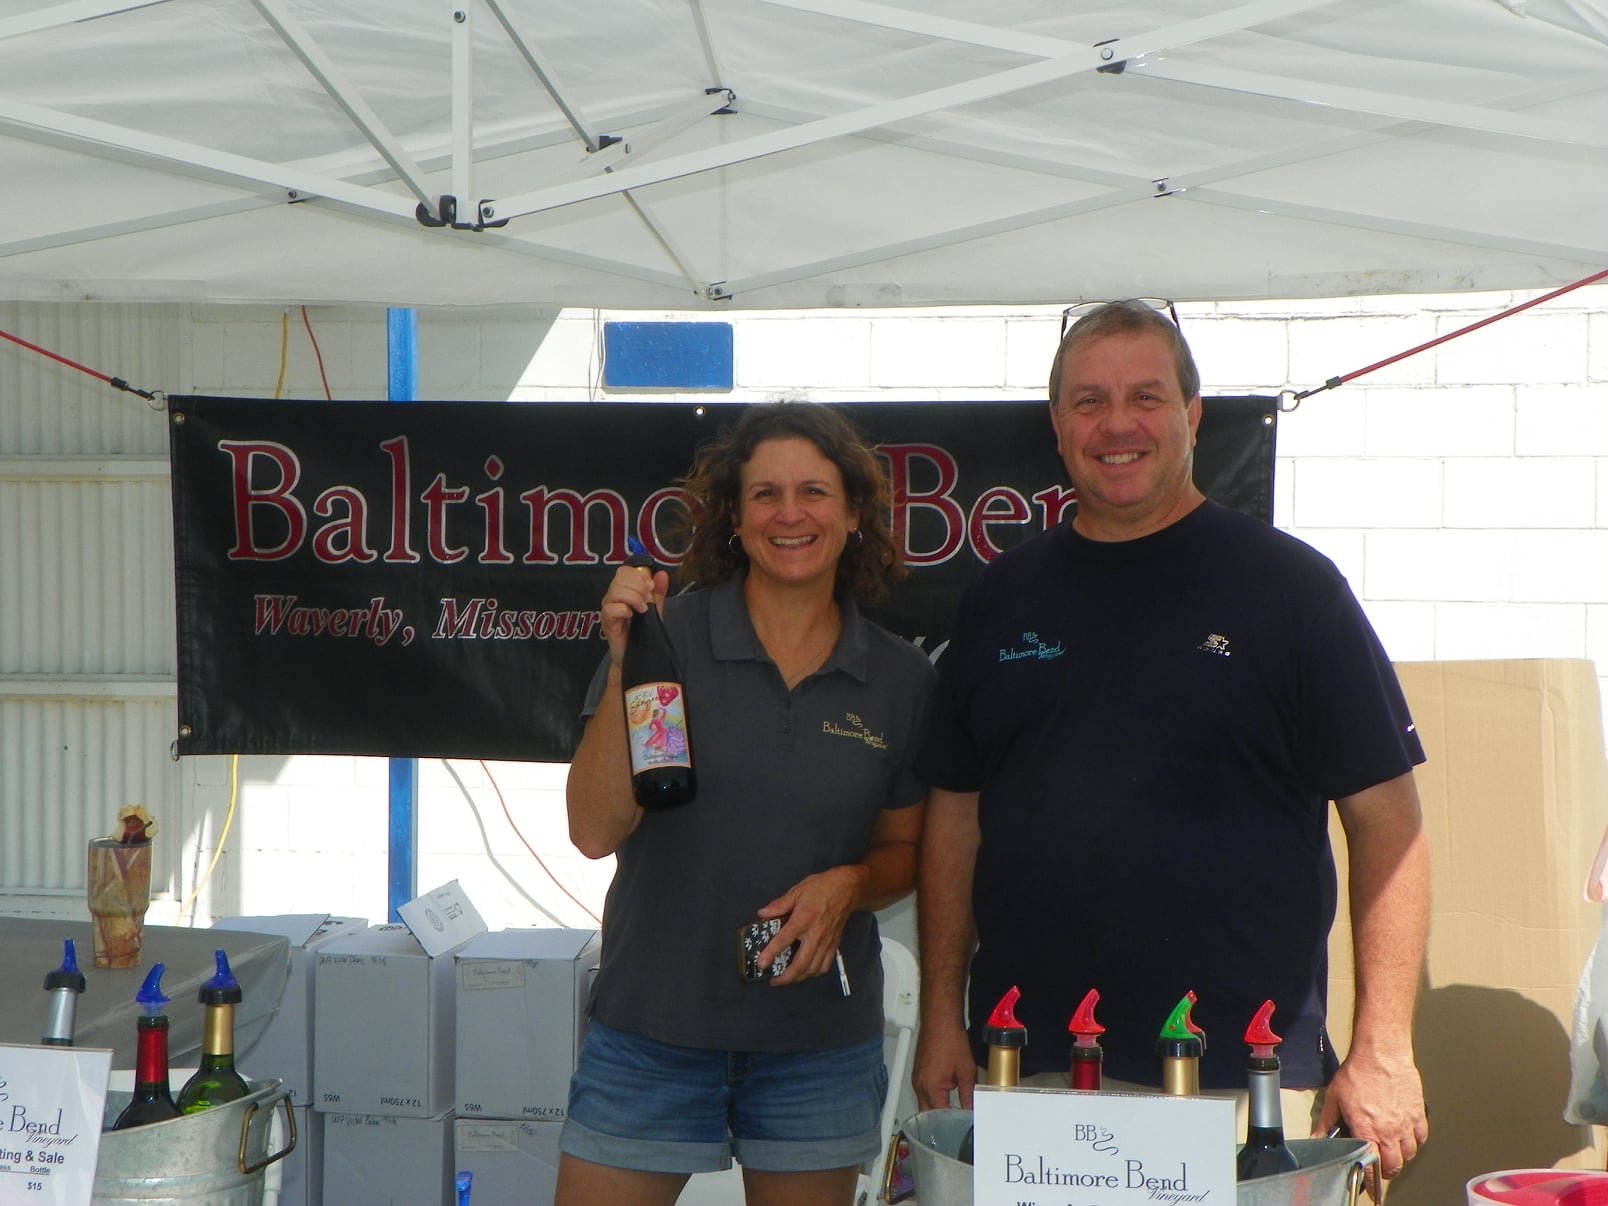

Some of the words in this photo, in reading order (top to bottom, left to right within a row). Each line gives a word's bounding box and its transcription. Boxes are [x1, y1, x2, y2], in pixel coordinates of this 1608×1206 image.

[254, 594, 415, 646] Waverly,
[432, 598, 608, 640] Missour
[999, 648, 1037, 662] Baltimore
[1038, 640, 1060, 655] Bend
[823, 721, 863, 739] Baltimore
[864, 728, 884, 744] Bend
[323, 1094, 341, 1103] W65
[464, 1103, 482, 1112] W65
[8, 1105, 63, 1135] Bend
[25, 1131, 78, 1148] Vineyard
[1075, 1124, 1097, 1141] BB
[25, 1151, 34, 1162] &
[38, 1151, 65, 1164] Sale
[30, 1165, 50, 1174] Bottle
[1004, 1154, 1118, 1188] Baltimore
[1125, 1160, 1188, 1191] Bend
[27, 1182, 42, 1191] $15
[1148, 1186, 1210, 1206] Vineyard
